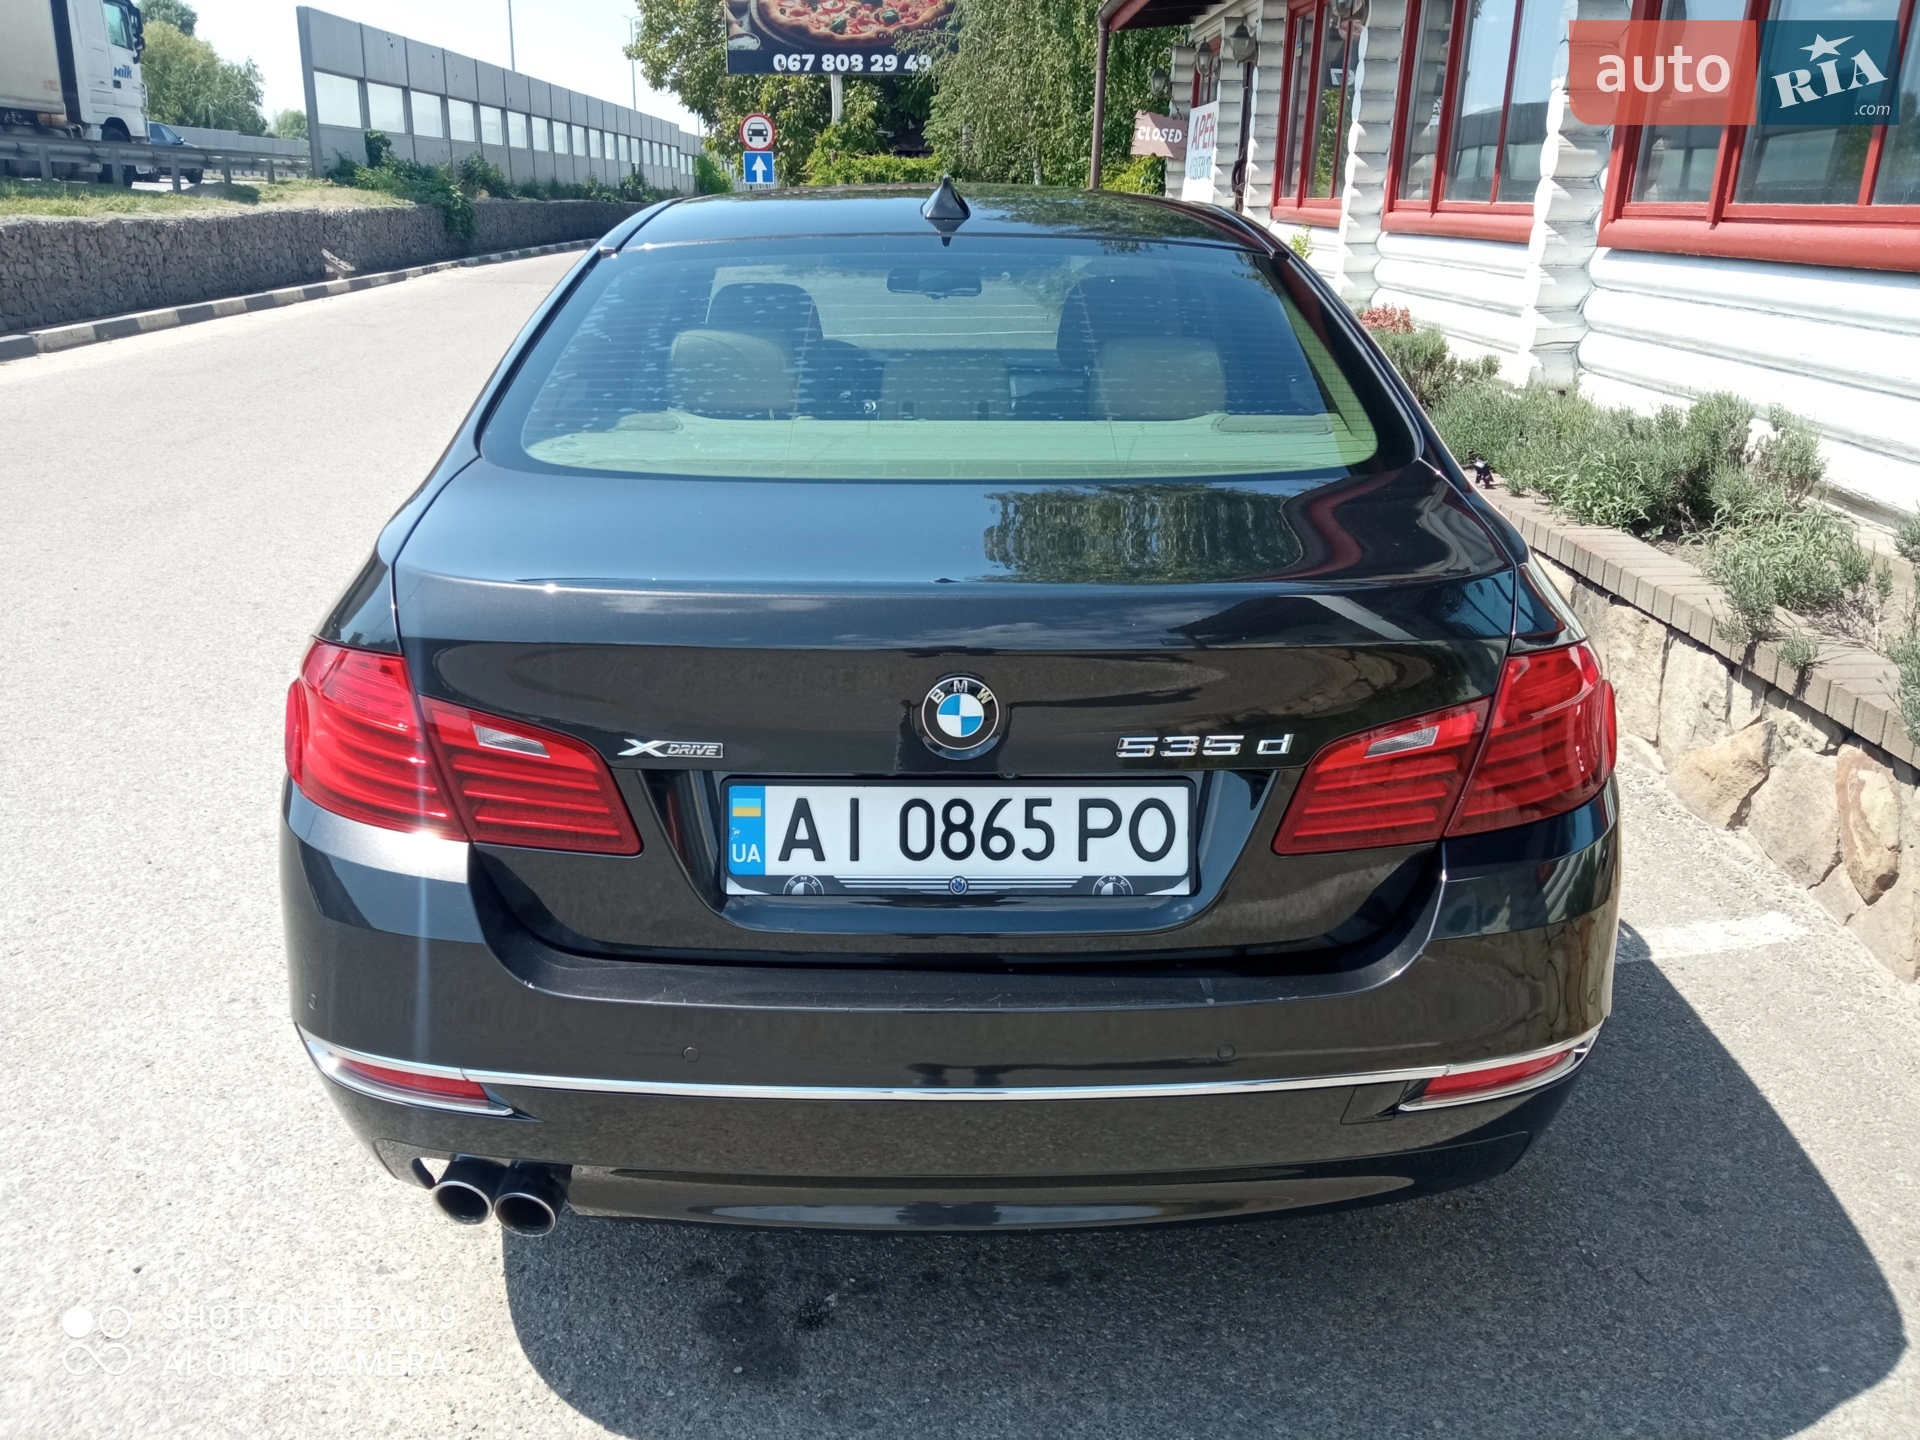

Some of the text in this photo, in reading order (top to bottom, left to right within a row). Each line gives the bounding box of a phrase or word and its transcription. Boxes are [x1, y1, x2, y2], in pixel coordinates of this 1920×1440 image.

[773, 53, 933, 72] 067 808 29 49
[1137, 125, 1183, 144] CLOSED
[930, 680, 993, 704] BMW
[1116, 734, 1294, 758] 535 d
[778, 797, 1176, 862] AI 0865 PO
[732, 843, 762, 863] UA
[788, 876, 819, 887] BMW
[1097, 876, 1128, 887] BMW
